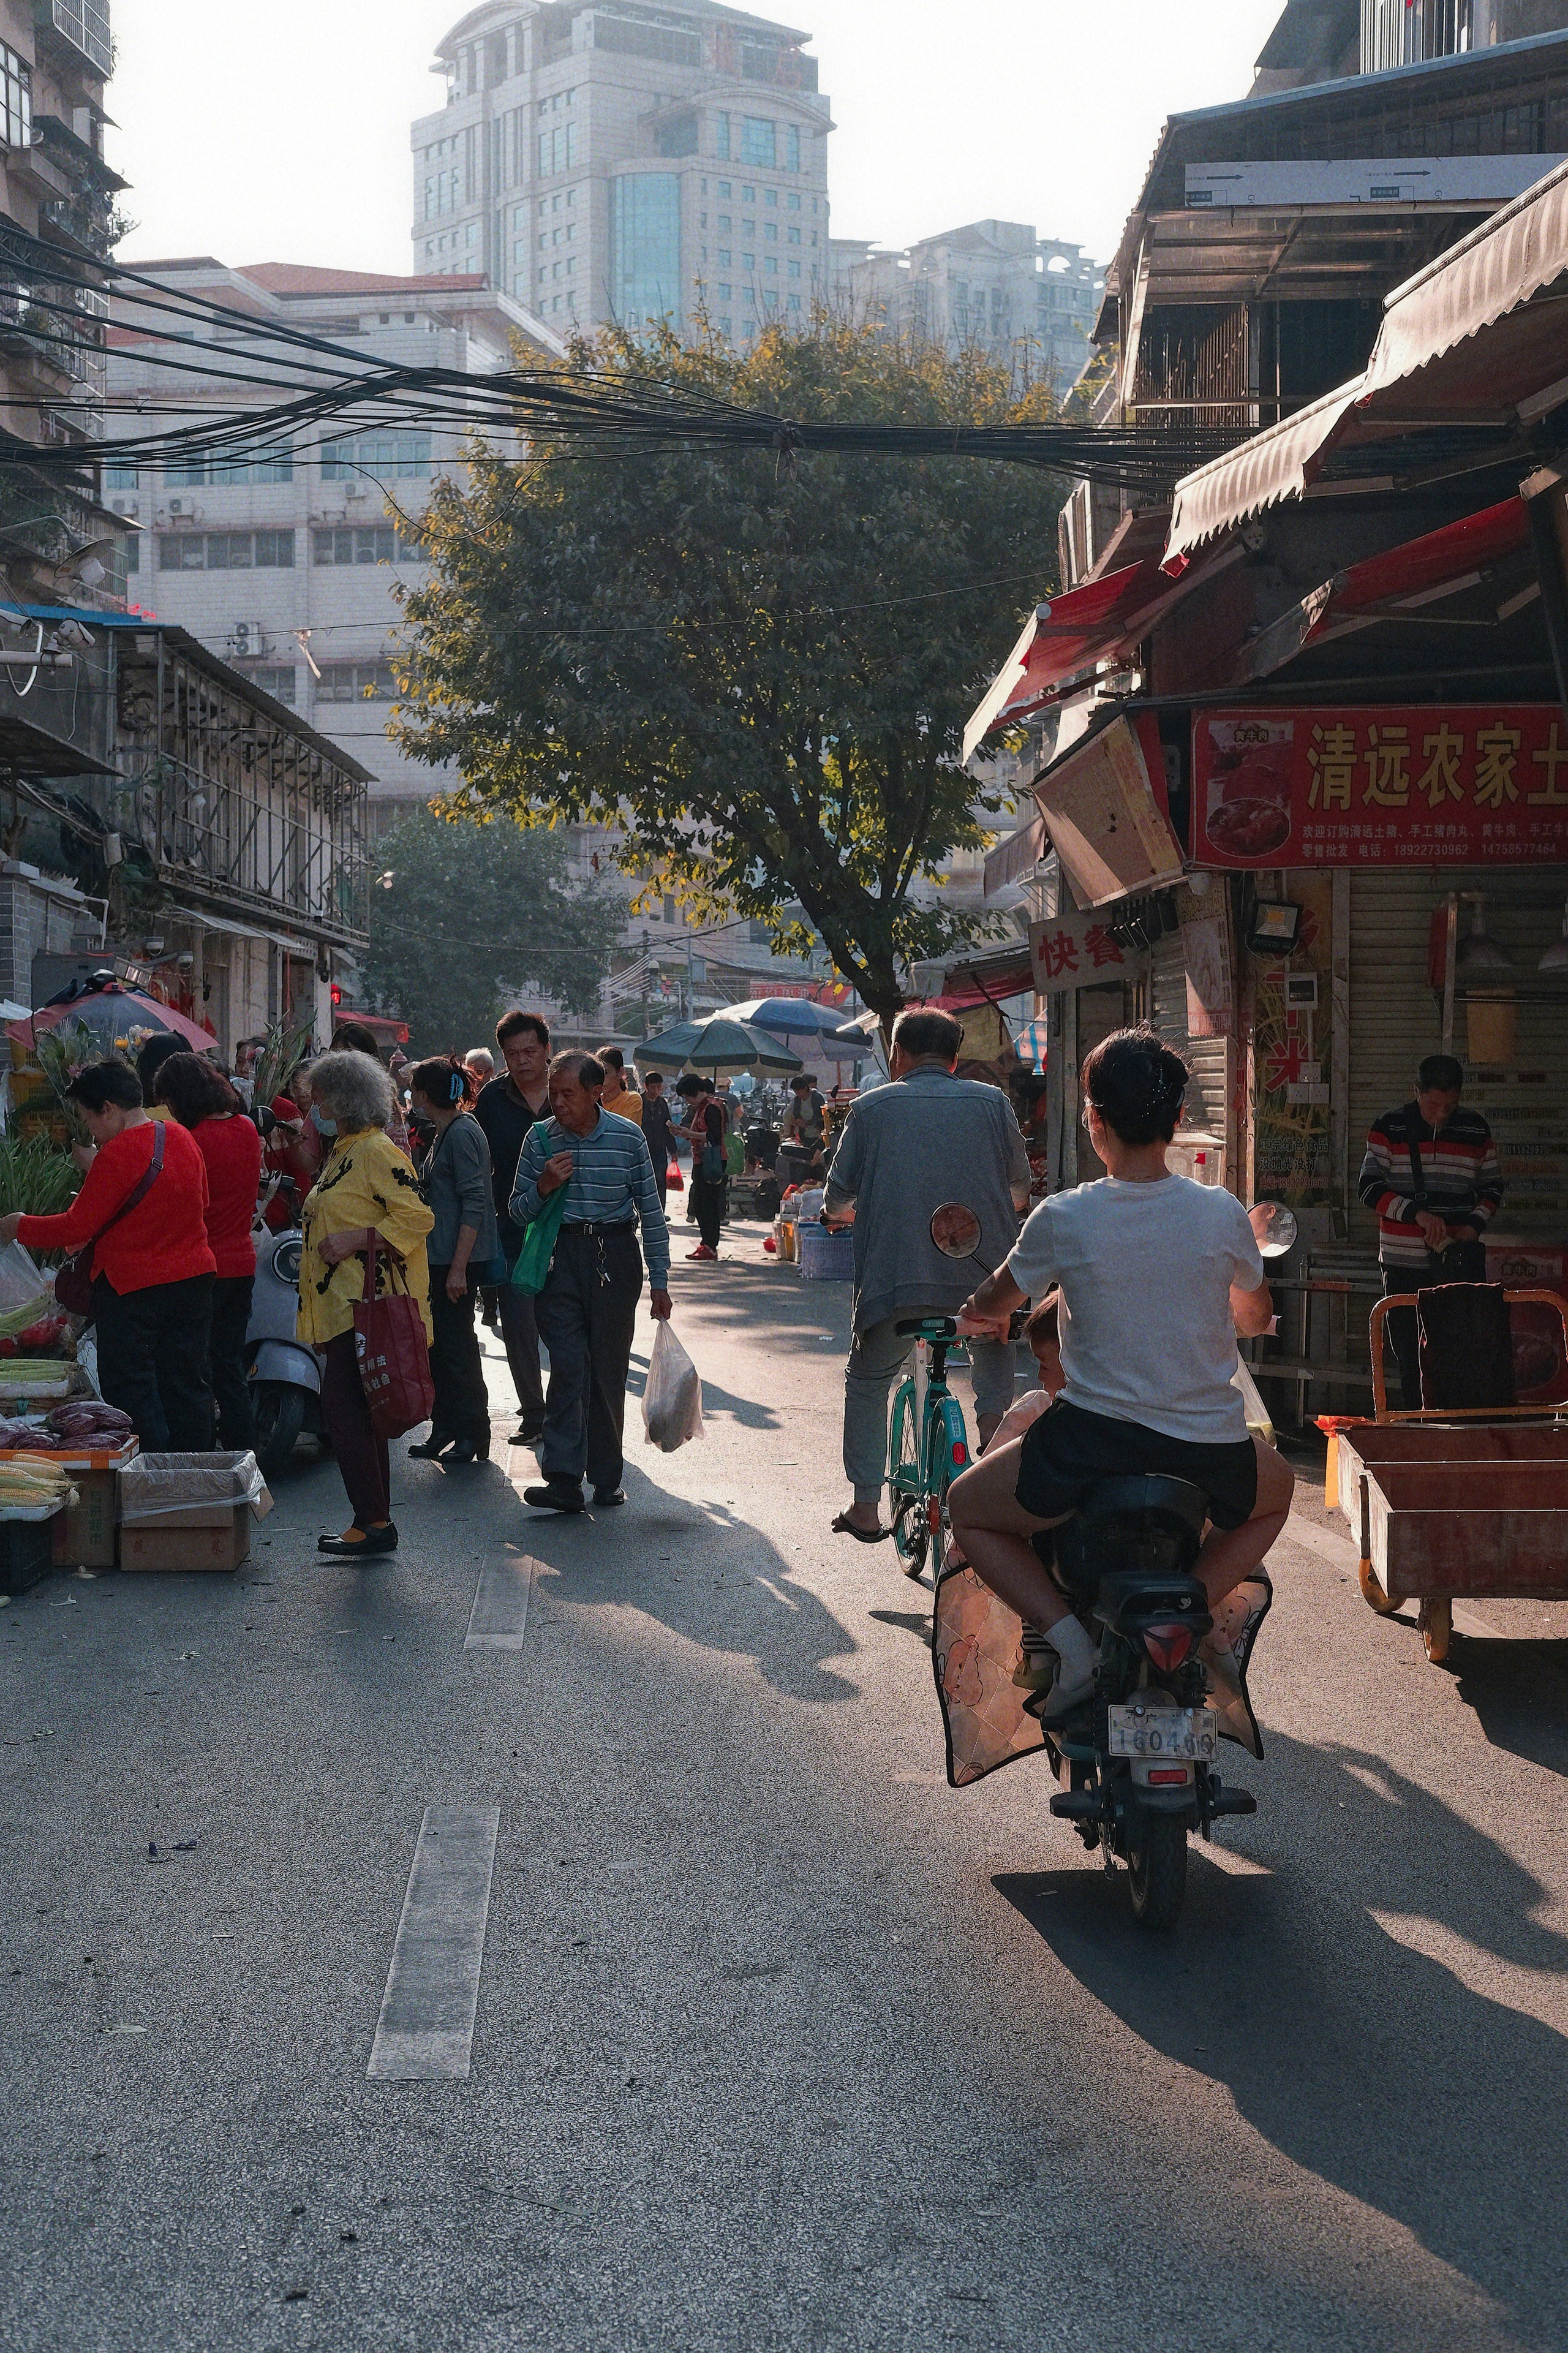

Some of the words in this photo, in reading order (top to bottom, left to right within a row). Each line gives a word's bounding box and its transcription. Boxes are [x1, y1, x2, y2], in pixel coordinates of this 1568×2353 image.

[1234, 728, 1268, 742] 黄牛肉
[1306, 721, 1568, 810] 清远农家土
[1302, 843, 1349, 858] 零售批发
[1038, 923, 1125, 978] 快餐
[1259, 1138, 1329, 1152] 正宗绿色食品
